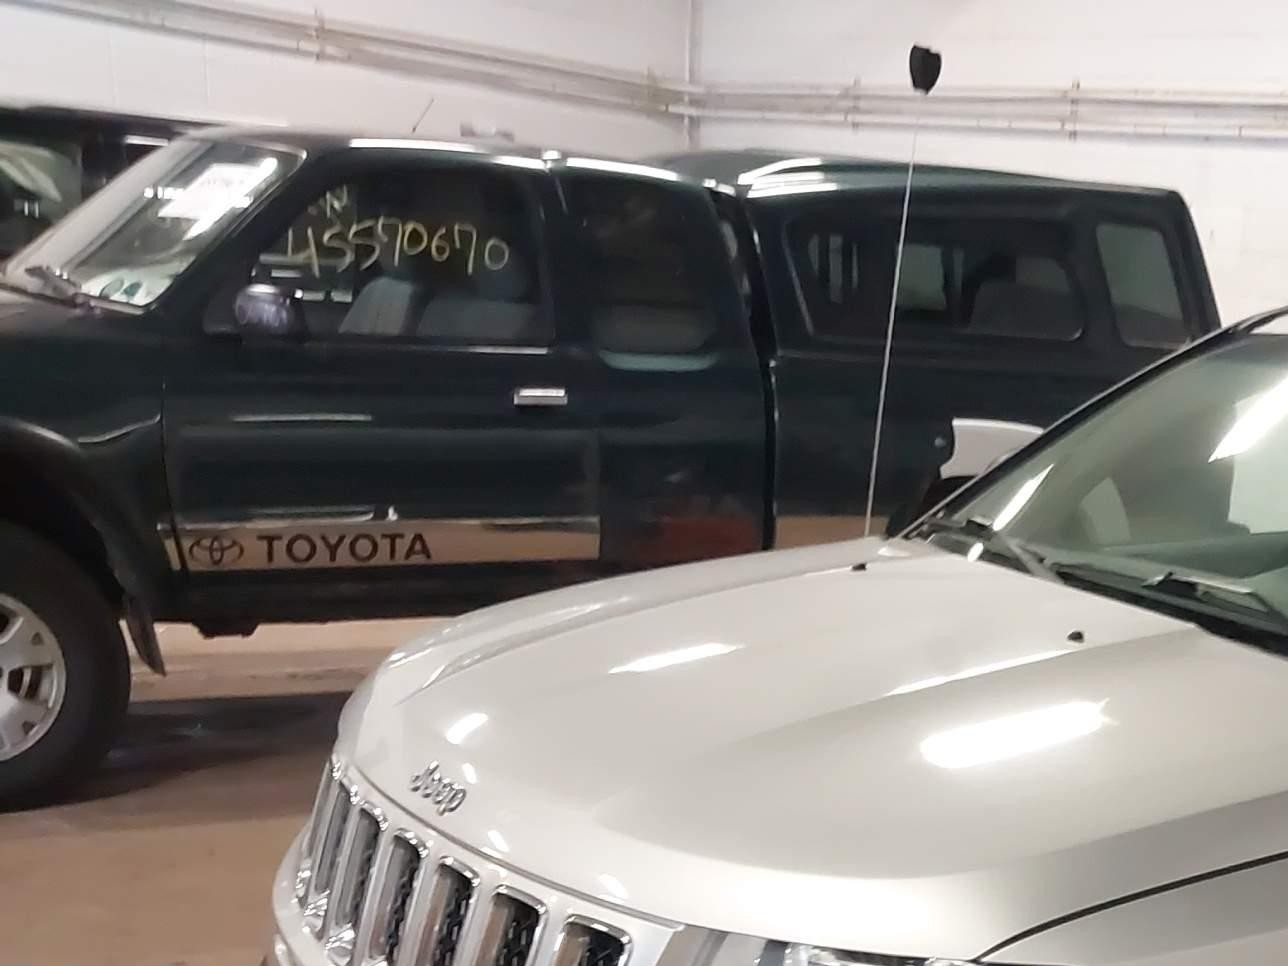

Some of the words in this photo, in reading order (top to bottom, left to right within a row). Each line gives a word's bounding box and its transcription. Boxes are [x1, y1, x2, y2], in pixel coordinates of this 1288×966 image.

[281, 214, 511, 279] 45570670
[256, 532, 434, 564] TOYOTA
[409, 760, 467, 816] Jeep
